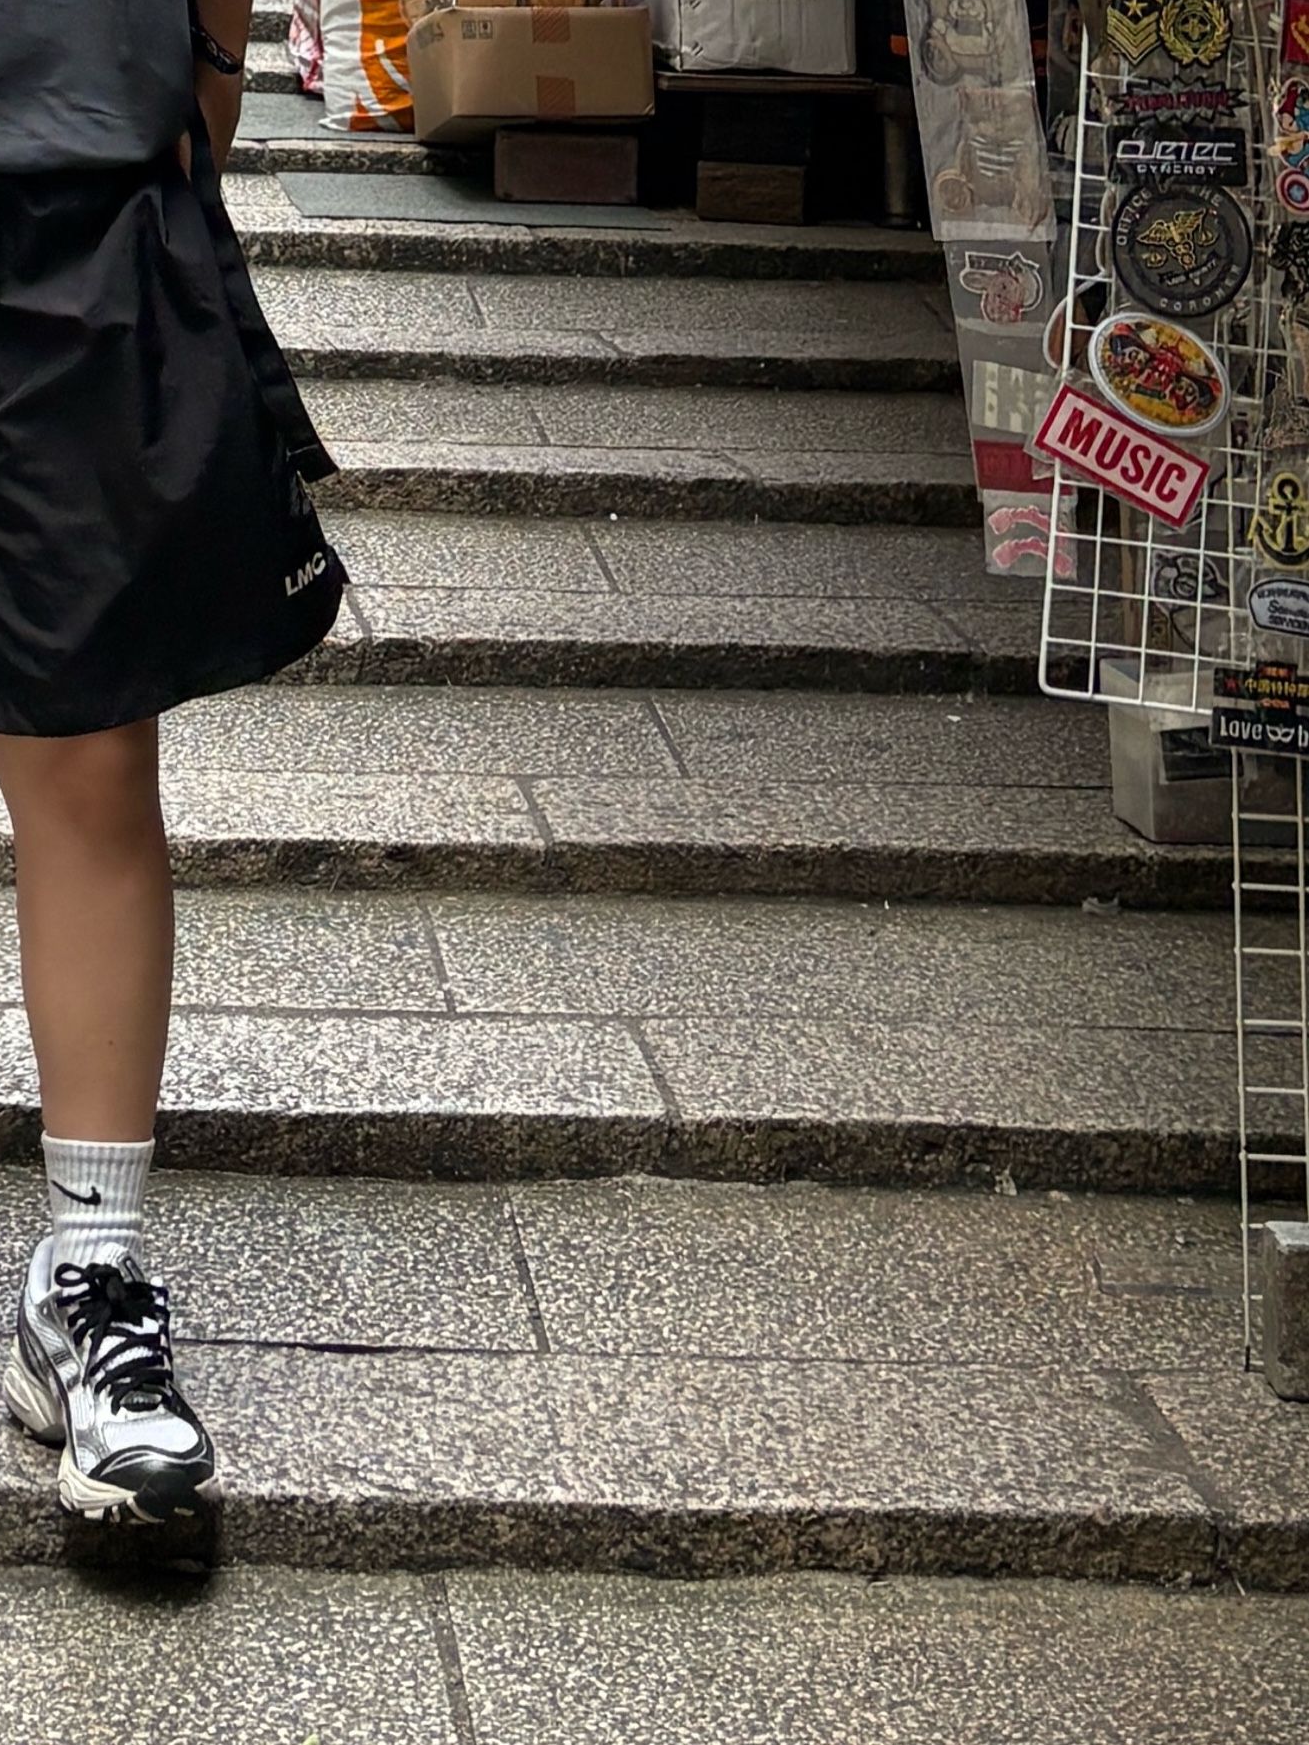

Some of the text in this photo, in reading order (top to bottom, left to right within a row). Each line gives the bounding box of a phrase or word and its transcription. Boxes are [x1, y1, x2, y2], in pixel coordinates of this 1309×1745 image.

[1057, 406, 1187, 503] MUSIC
[284, 551, 326, 596] LMC
[1220, 715, 1263, 741] Love
